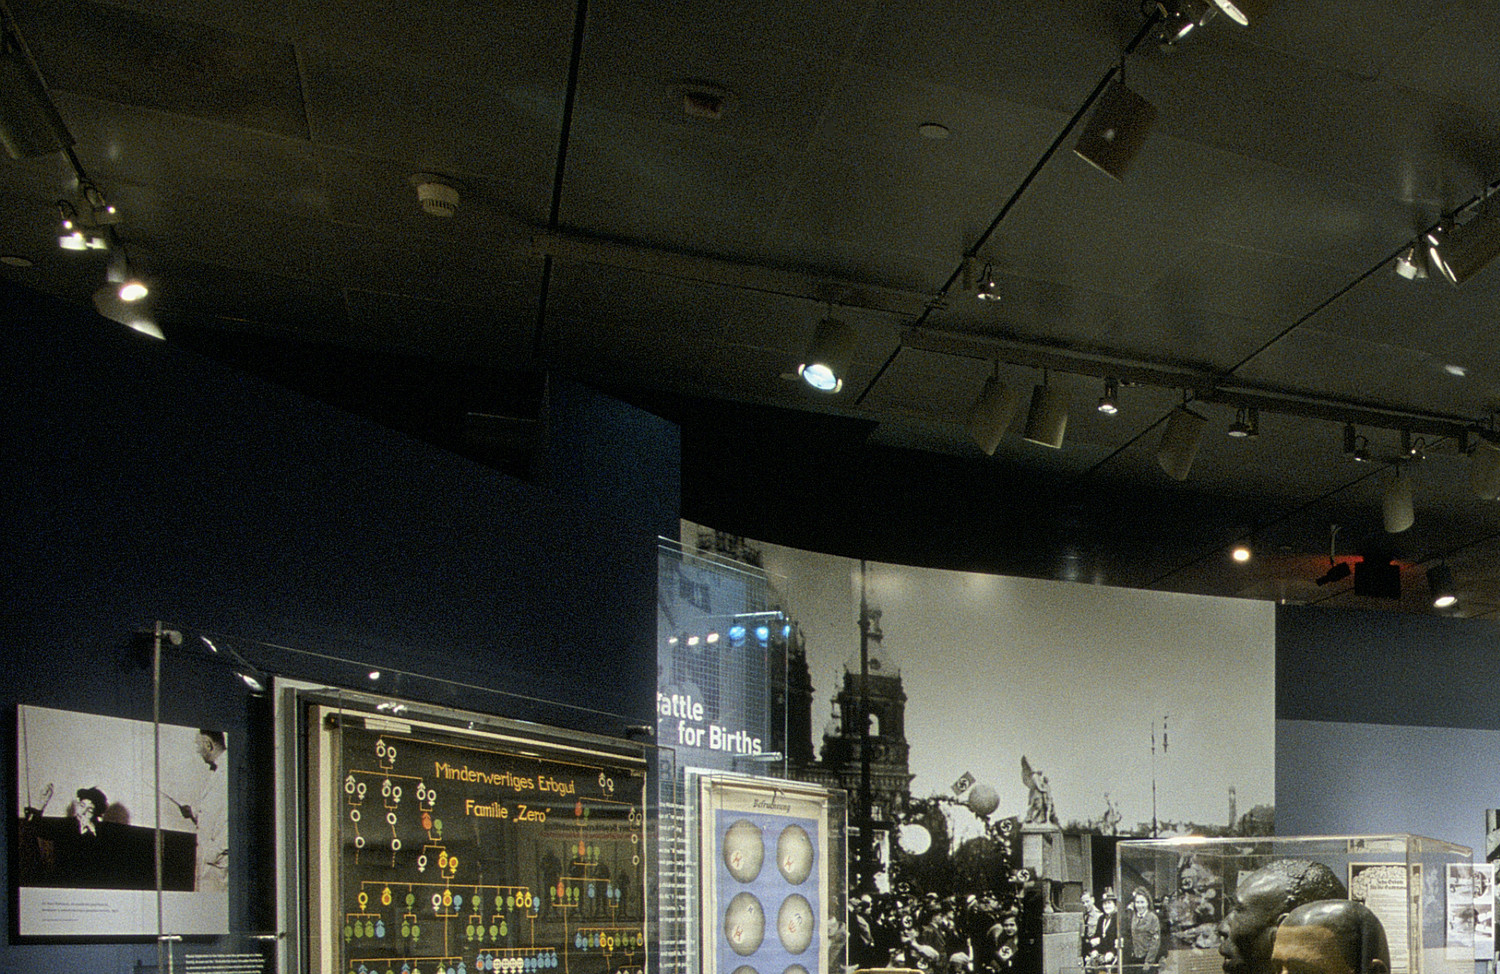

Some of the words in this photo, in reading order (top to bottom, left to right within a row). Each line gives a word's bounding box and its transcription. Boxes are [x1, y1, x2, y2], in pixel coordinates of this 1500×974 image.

[678, 720, 705, 747] for
[709, 725, 762, 754] Births
[466, 799, 508, 818] Familie
